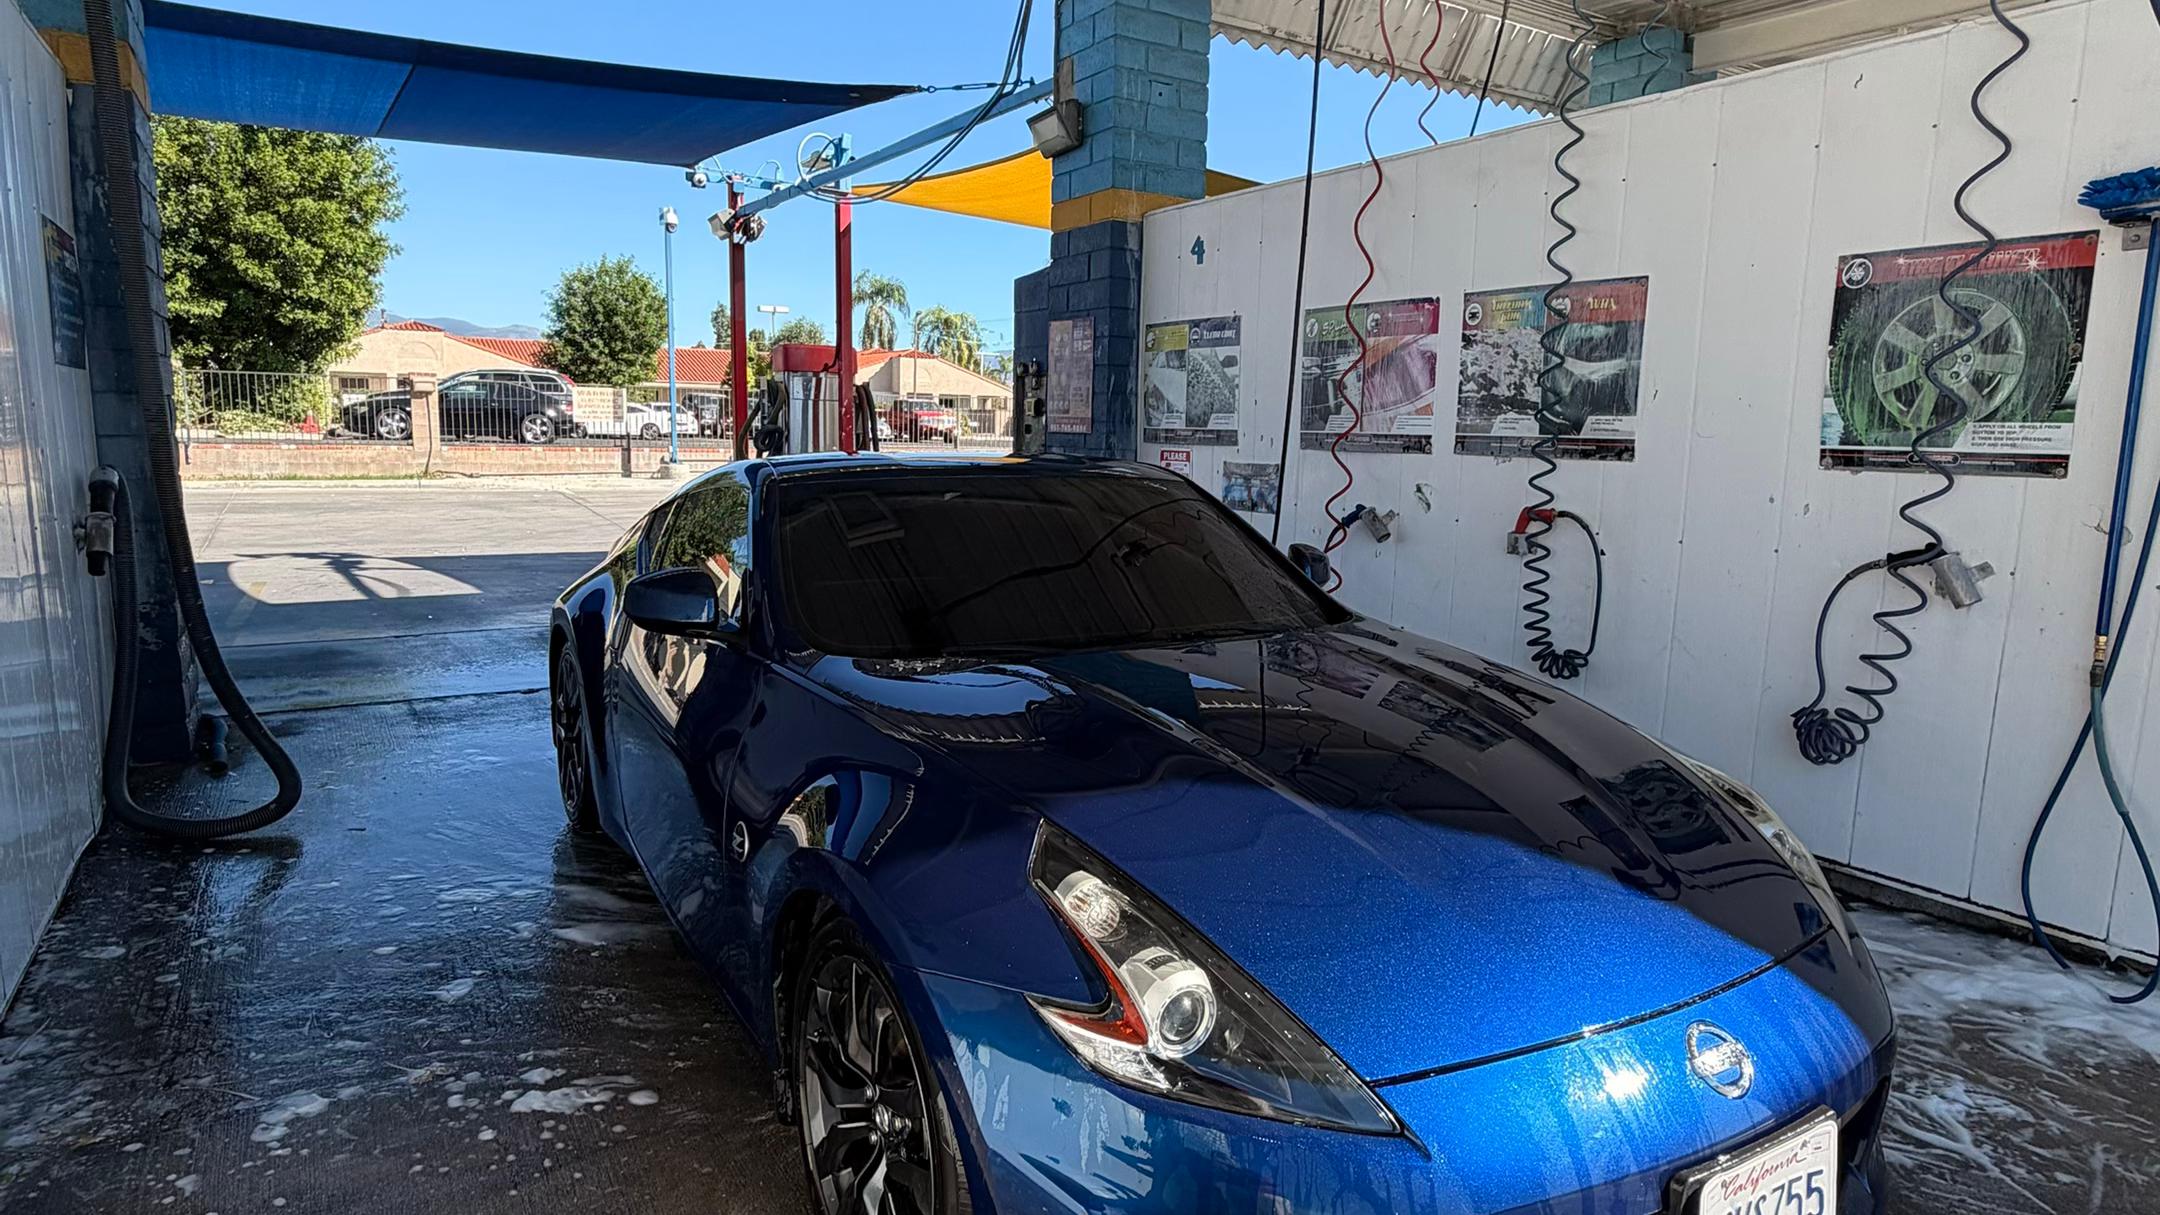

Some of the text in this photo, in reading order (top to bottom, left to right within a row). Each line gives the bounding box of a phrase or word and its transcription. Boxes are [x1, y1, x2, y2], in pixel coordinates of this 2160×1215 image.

[1190, 235, 1206, 265] 4
[1163, 452, 1187, 461] PLEASE
[1721, 1151, 1808, 1200] California
